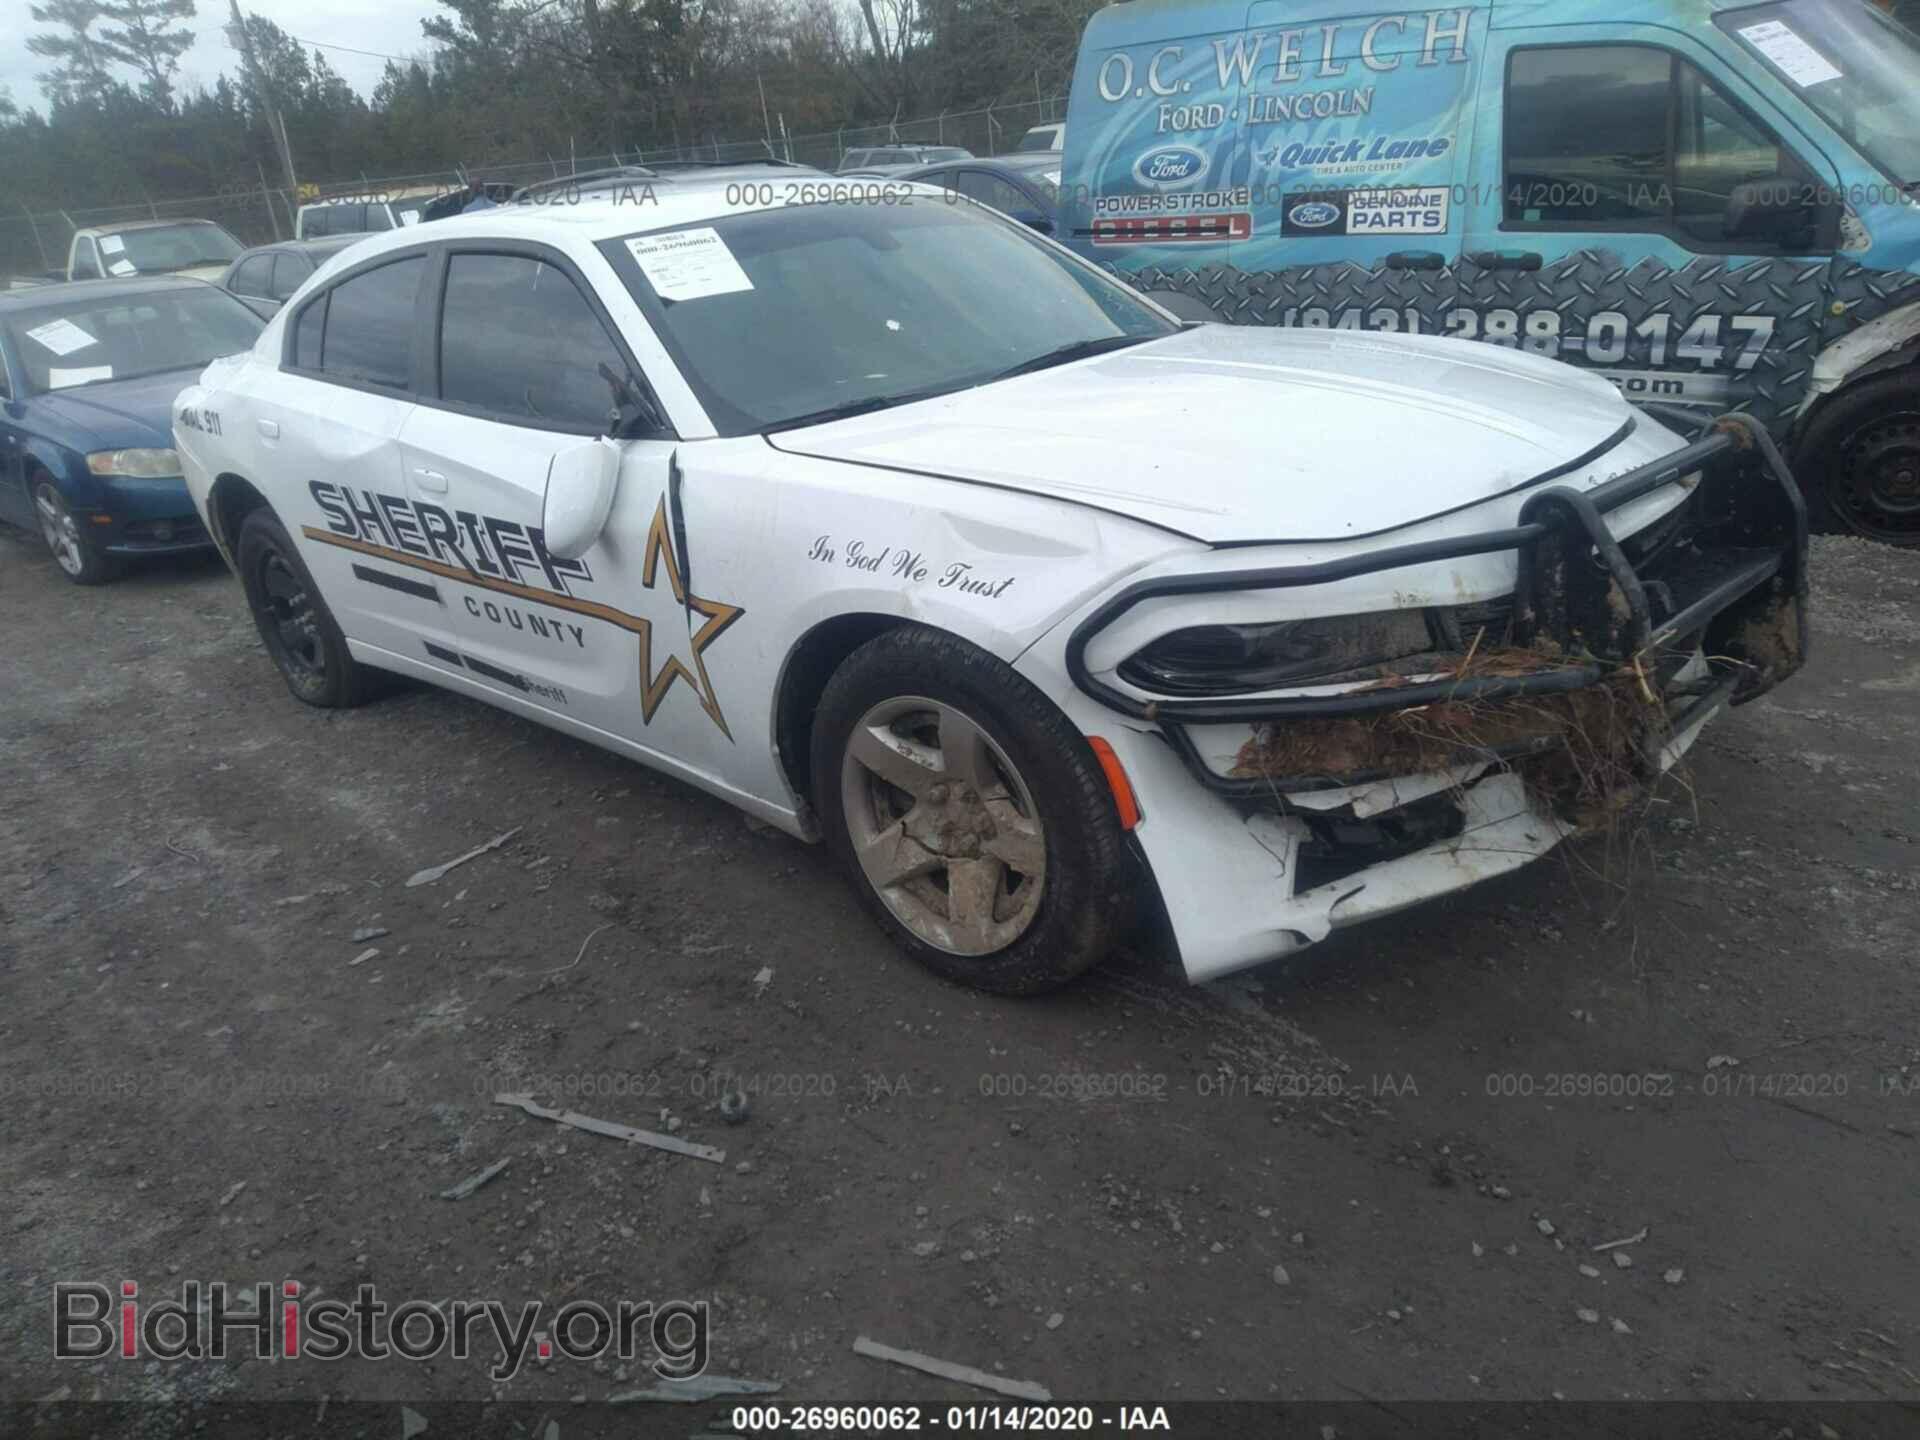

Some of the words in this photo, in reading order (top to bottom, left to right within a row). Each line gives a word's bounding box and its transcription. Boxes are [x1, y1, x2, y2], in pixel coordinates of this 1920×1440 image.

[1097, 46, 1194, 101] O.C.
[1212, 8, 1474, 88] WELCH
[1150, 154, 1190, 178] Ford
[1279, 138, 1363, 169] Quick
[1366, 136, 1450, 160] Lane
[1300, 206, 1327, 222] Ford
[1354, 194, 1441, 209] GENUINE
[1352, 210, 1440, 229] PARTS
[1446, 309, 1776, 370] 288-0147
[204, 409, 222, 437] 911
[308, 479, 594, 598] SHERIFF
[808, 535, 834, 563] In
[846, 540, 890, 573] God
[892, 549, 928, 582] We
[938, 562, 1016, 599] Trust
[463, 596, 584, 648] COUNTY
